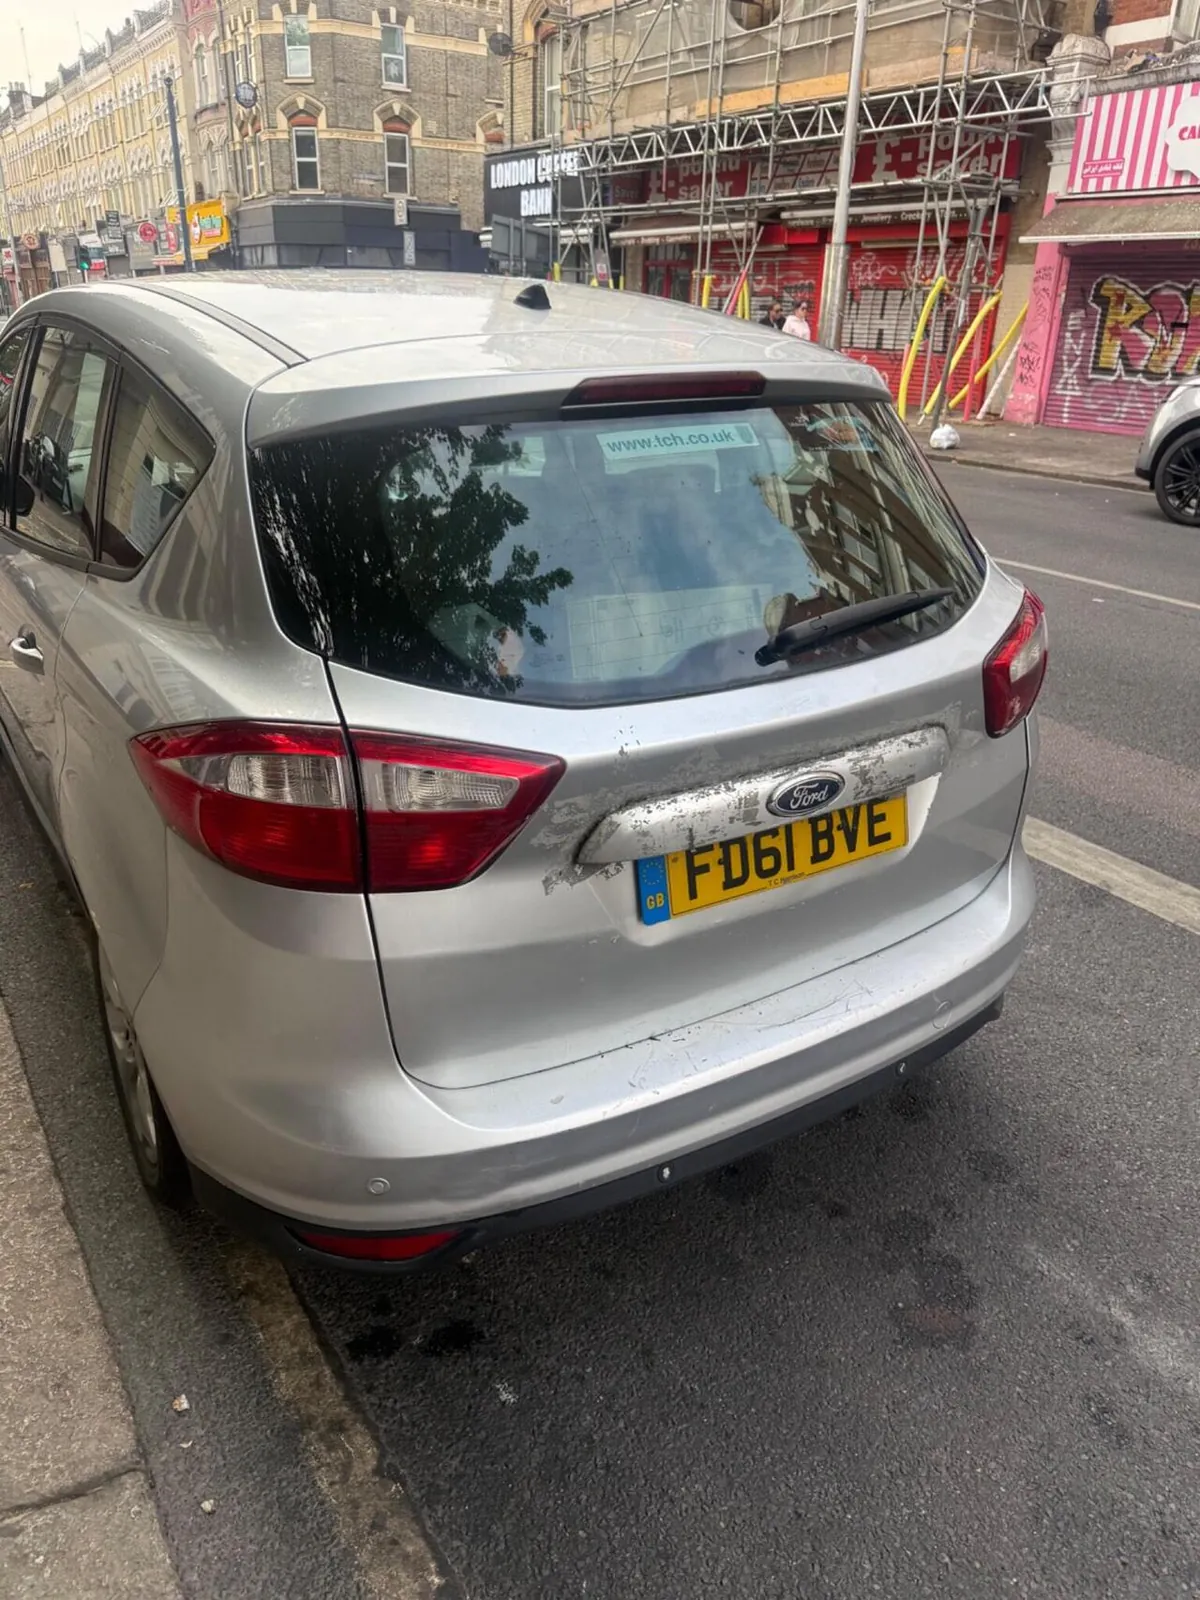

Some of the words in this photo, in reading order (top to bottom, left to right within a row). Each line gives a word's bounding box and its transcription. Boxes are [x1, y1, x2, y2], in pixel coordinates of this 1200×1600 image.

[491, 158, 536, 189] LONDON
[606, 429, 735, 453] www.tch.co.uk
[790, 782, 828, 809] Ford
[646, 892, 665, 910] GB
[685, 825, 795, 901] FD61
[808, 798, 892, 865] BVE
